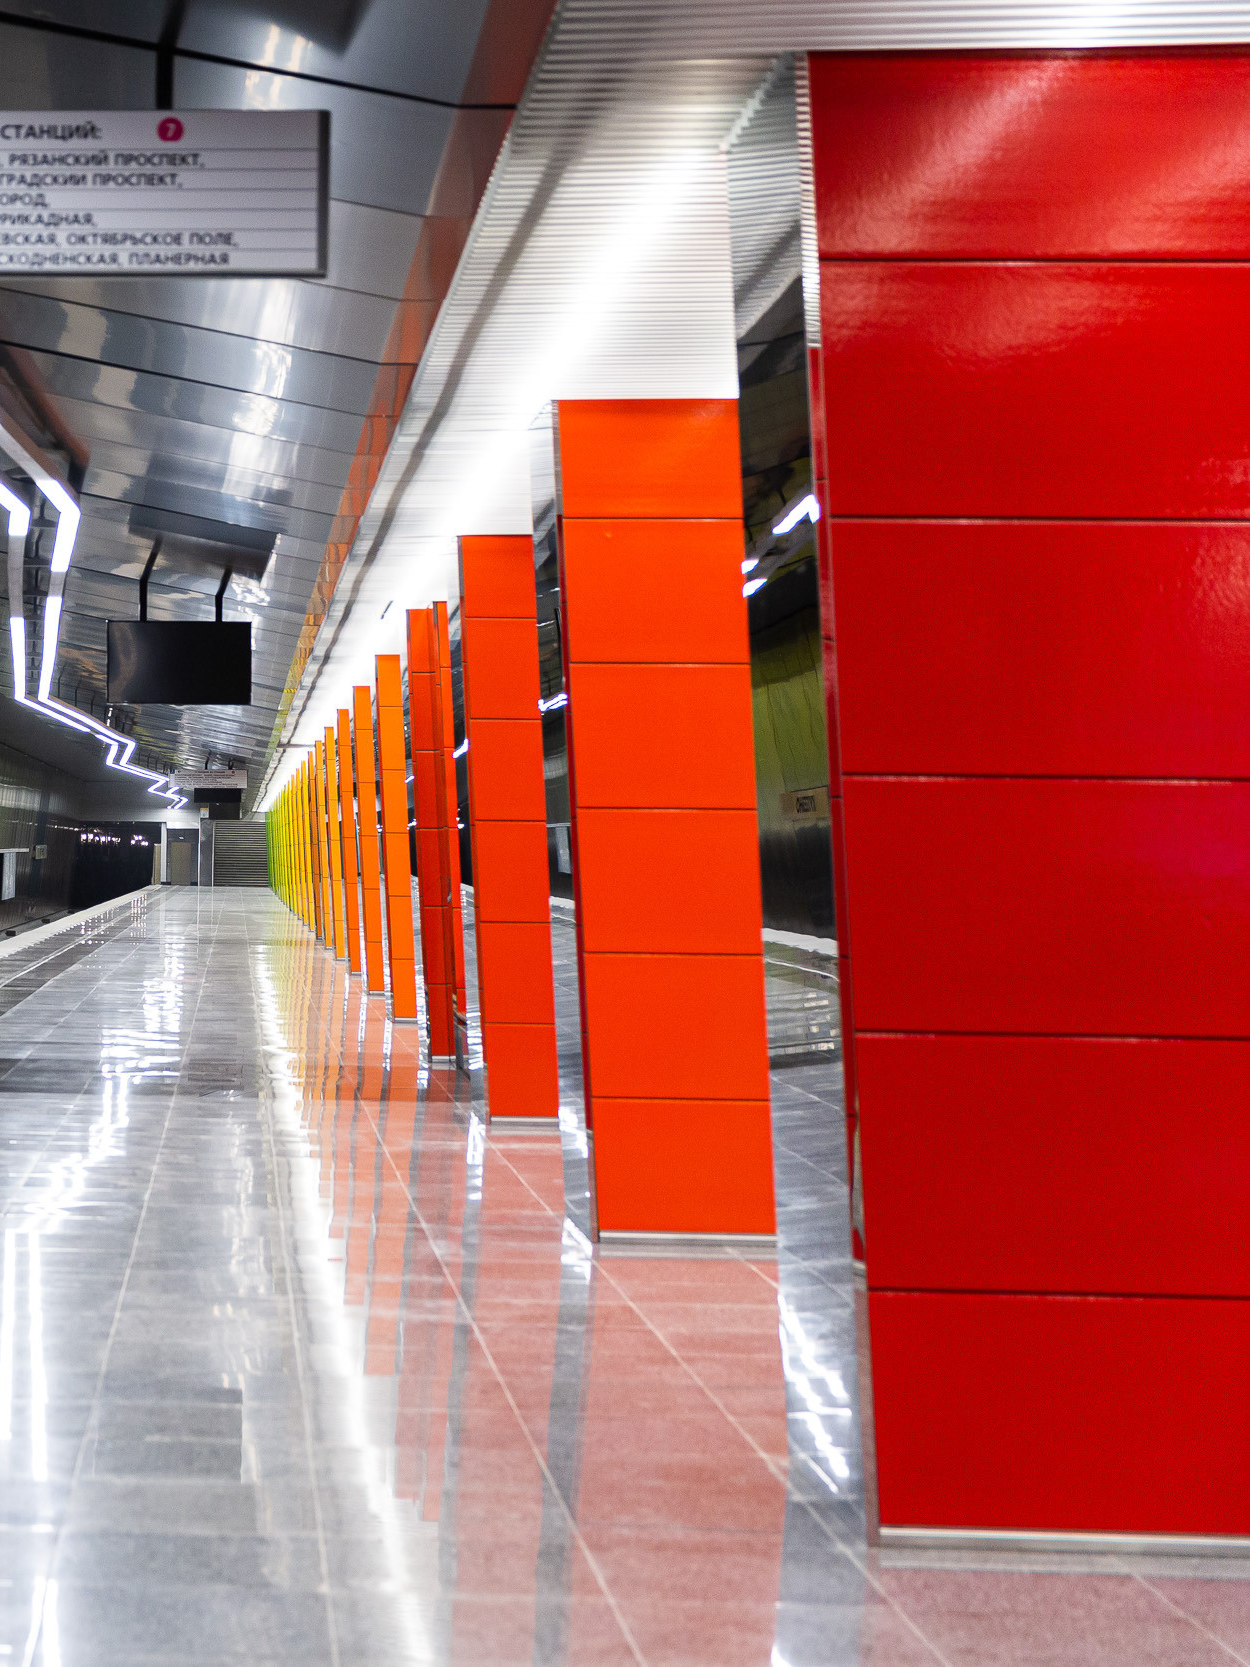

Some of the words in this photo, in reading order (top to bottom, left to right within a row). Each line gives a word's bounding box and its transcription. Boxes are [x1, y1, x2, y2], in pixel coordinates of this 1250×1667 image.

[0, 121, 101, 141] СТАНЦИЙ:
[165, 123, 176, 138] 7
[9, 150, 109, 166] РЯЗАНСКИЙ
[114, 153, 205, 168] ПРОСПЕКТ,
[92, 173, 183, 188] ПРОСПЕКТ,
[67, 232, 182, 246] ОКТЯБРЬСКОЕ
[189, 232, 239, 247] ПОЛЕ,
[128, 252, 230, 266] ПЛАНЕРНАЯ
